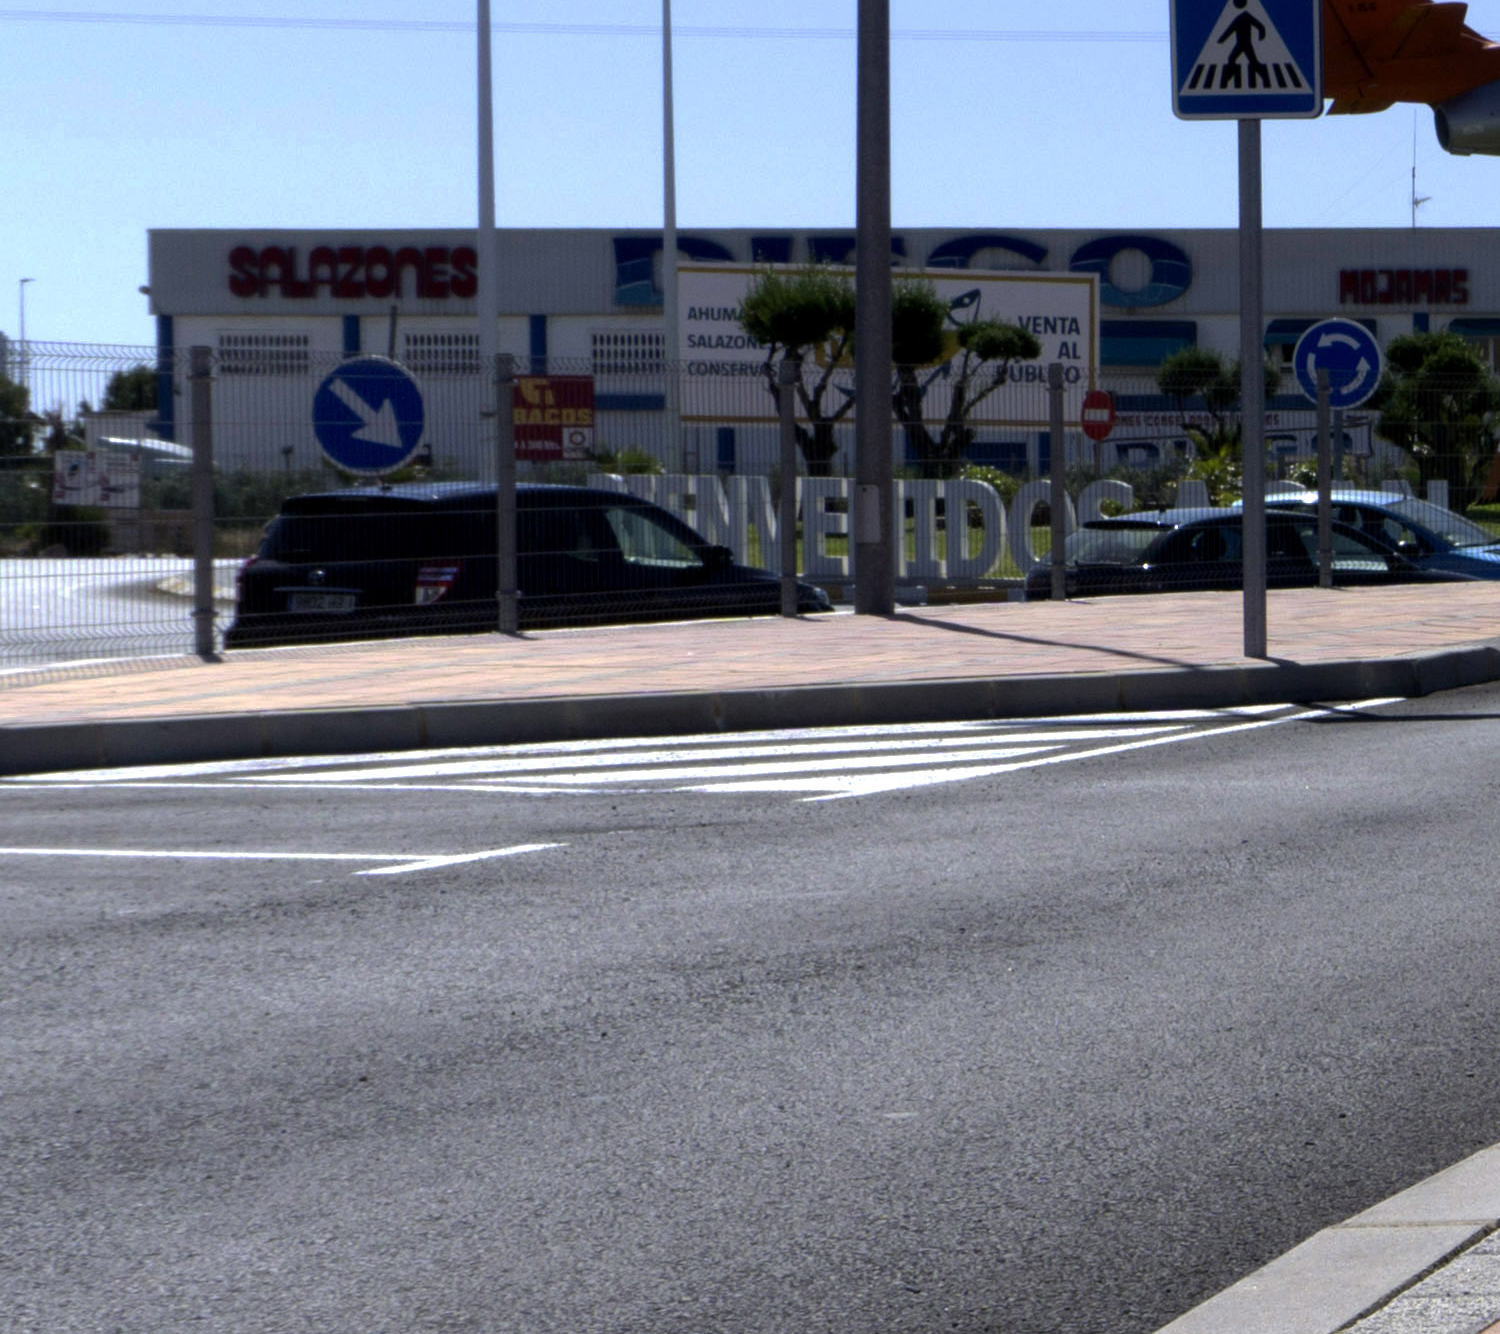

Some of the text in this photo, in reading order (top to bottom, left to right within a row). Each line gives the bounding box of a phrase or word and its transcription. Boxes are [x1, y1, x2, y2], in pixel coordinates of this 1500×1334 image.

[228, 245, 480, 299] SALAZONES
[1340, 269, 1469, 305] MOJAMAS
[1018, 315, 1081, 335] VENTA
[1058, 341, 1081, 360] AL
[512, 407, 594, 426] BACOS
